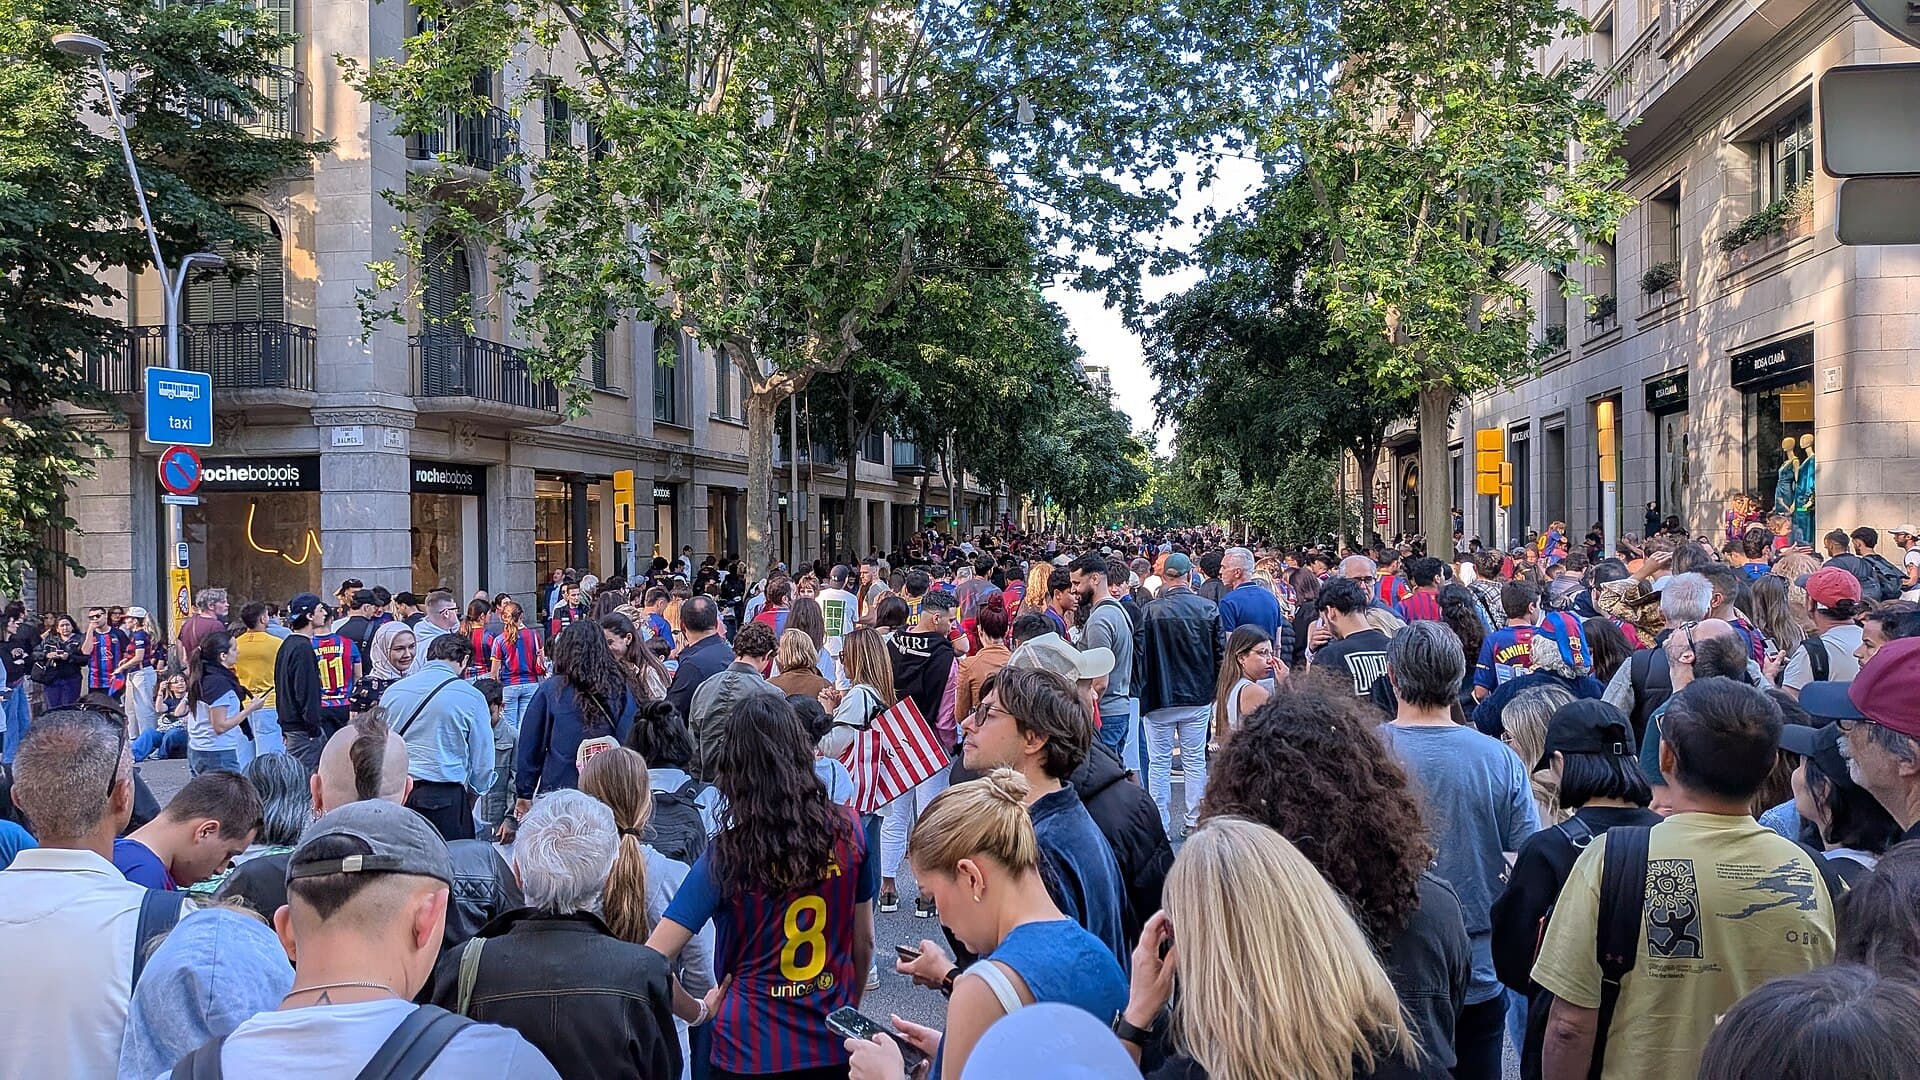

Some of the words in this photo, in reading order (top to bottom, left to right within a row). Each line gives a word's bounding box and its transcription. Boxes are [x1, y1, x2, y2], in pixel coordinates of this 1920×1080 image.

[168, 415, 192, 430] taxi
[1495, 643, 1530, 663] LAMINE
[318, 656, 344, 690] 11
[780, 895, 827, 981] 8
[771, 982, 816, 998] unice
